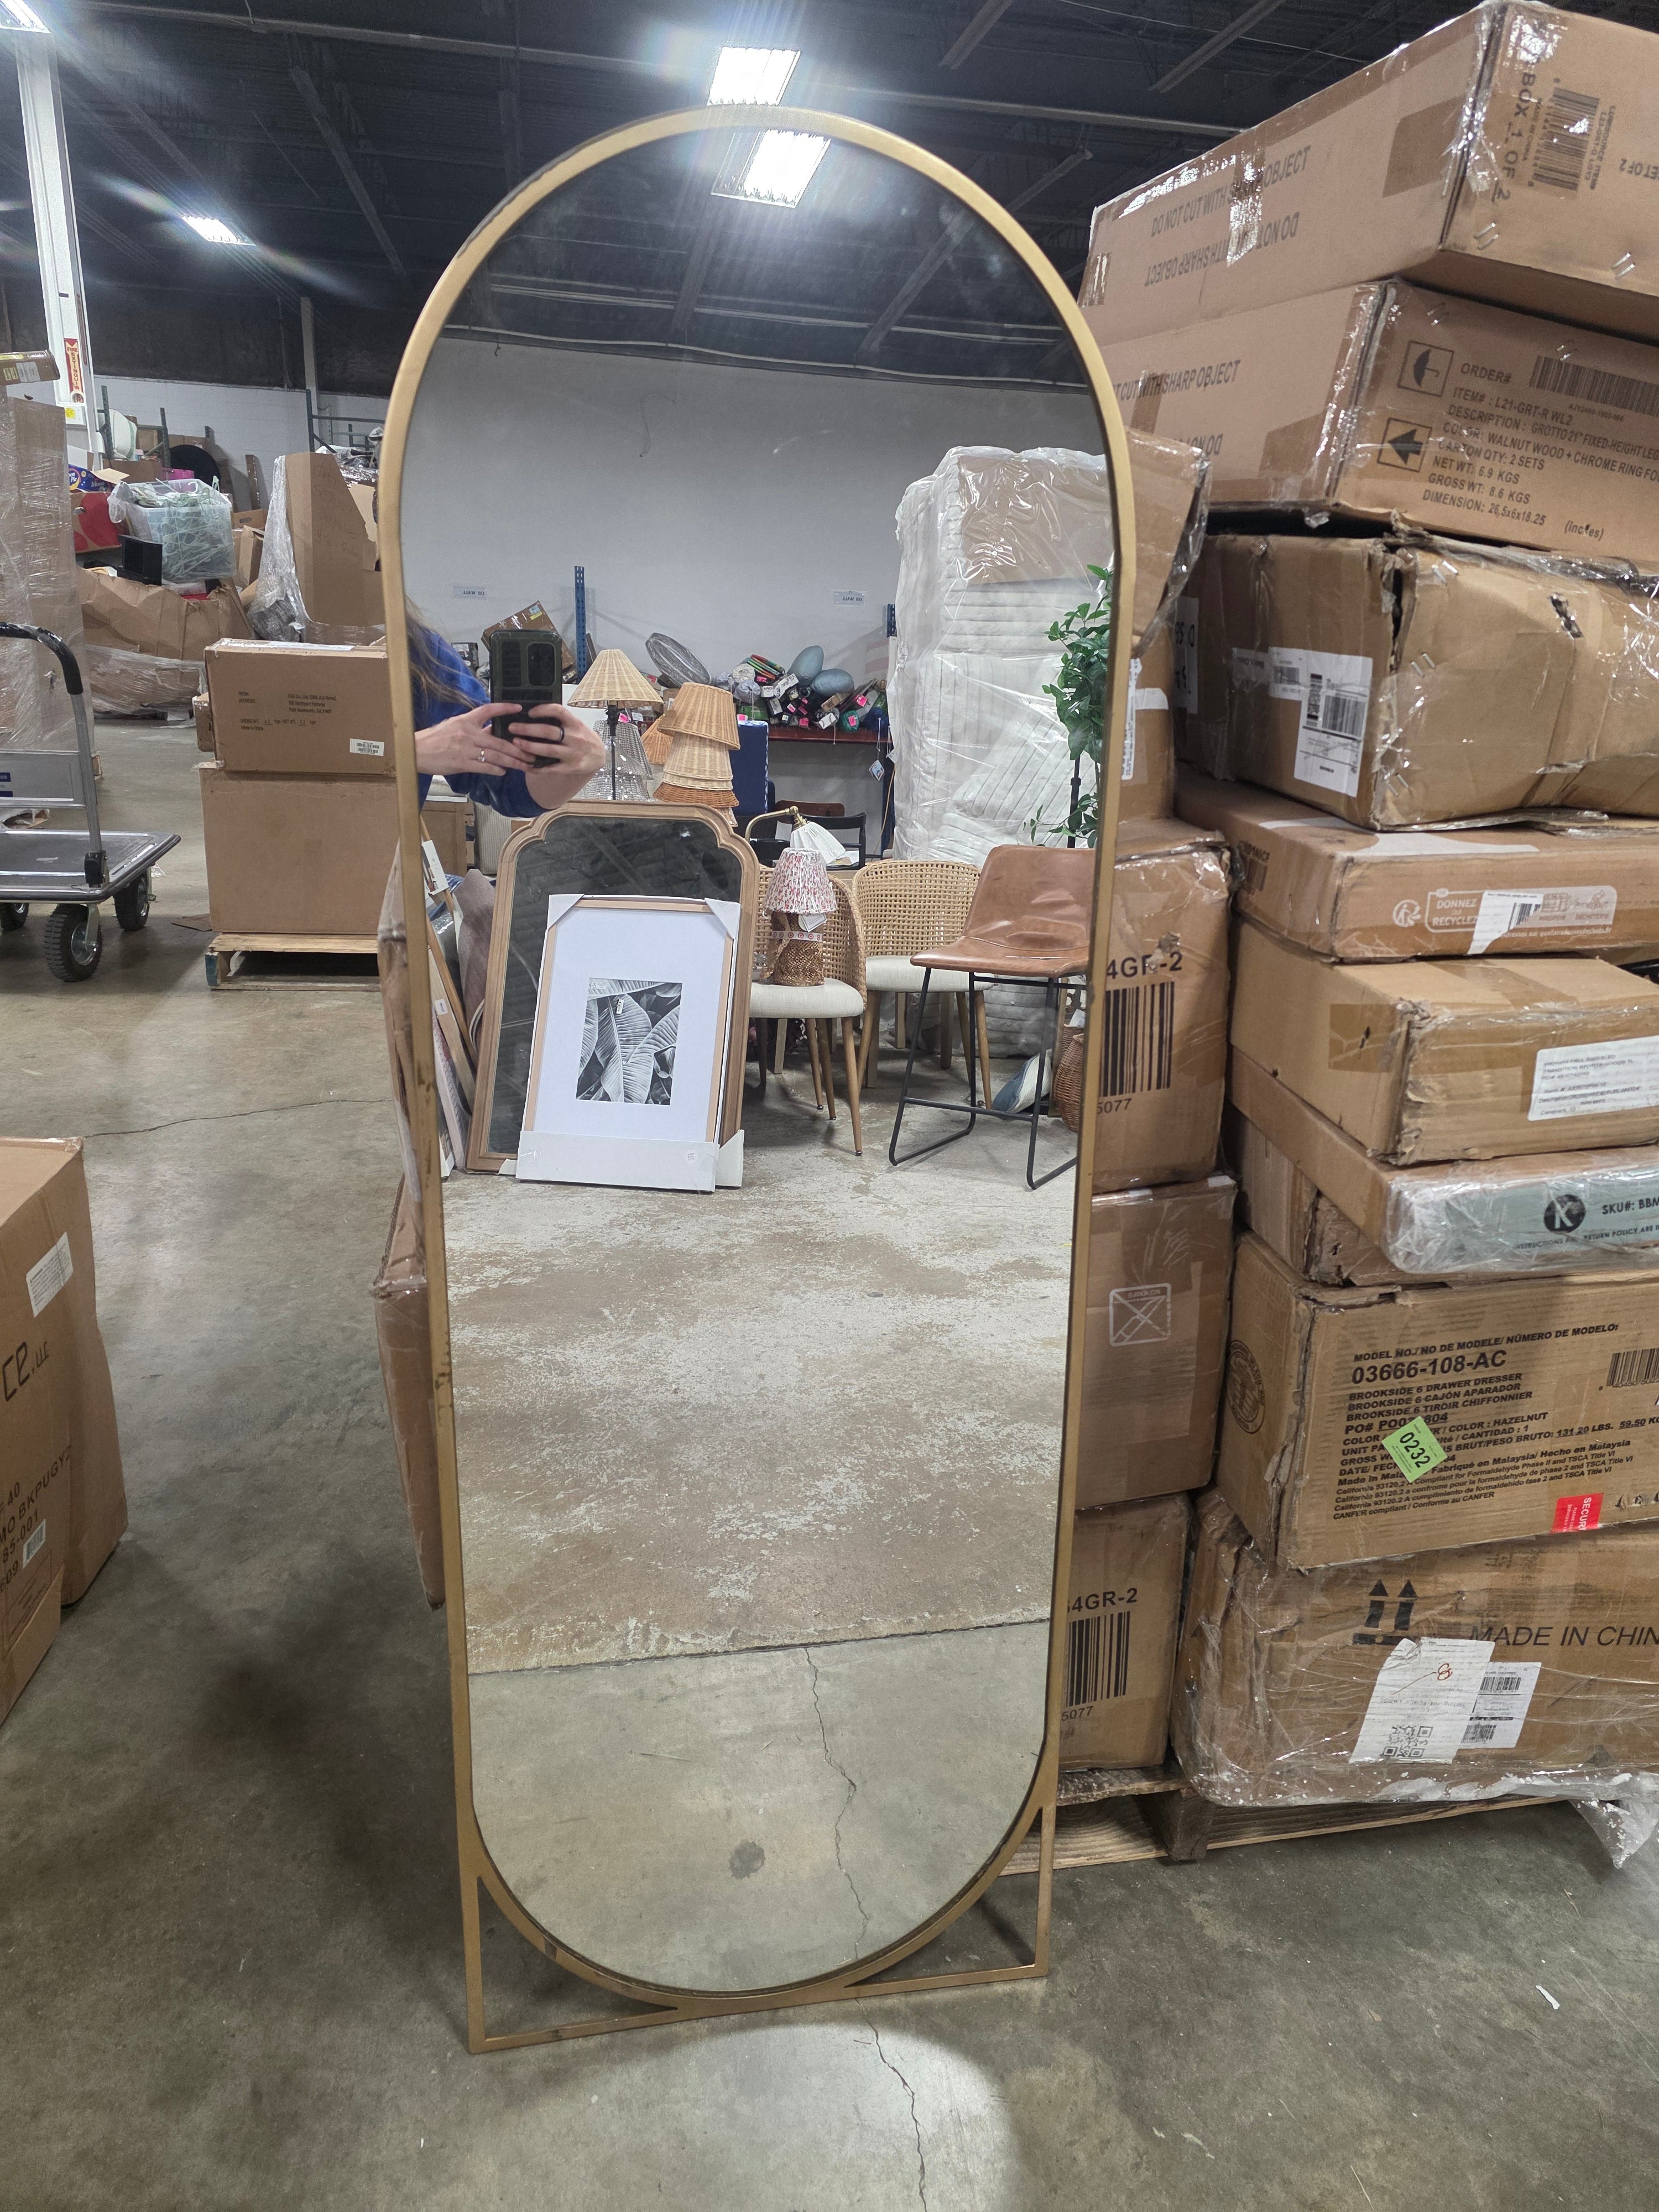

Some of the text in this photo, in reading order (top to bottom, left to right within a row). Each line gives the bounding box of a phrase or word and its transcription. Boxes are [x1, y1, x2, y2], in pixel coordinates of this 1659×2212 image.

[1503, 72, 1536, 179] BOX OF
[1619, 158, 1642, 175] OF 2
[1151, 216, 1163, 237] DO
[1164, 205, 1183, 230] NOT
[1184, 196, 1203, 224] CUT
[1264, 145, 1311, 188] OBJECT
[1282, 212, 1300, 241] DO
[1145, 257, 1178, 286] OBJECT
[1162, 368, 1196, 394] SHARP
[1197, 359, 1240, 388] OBJECT
[1461, 363, 1511, 384] ORDER#
[1453, 388, 1484, 404] ITEM#
[1448, 405, 1642, 457] DESCRIPTION GROTTO FIXED-HEIGHT
[1488, 432, 1531, 455] WALNUT
[1533, 444, 1563, 460] WOOD
[1574, 451, 1618, 472] CHROME
[1618, 462, 1643, 477] RING
[1510, 455, 1516, 465] 2
[1518, 457, 1545, 471] SETS
[1433, 456, 1454, 471] NET
[1498, 470, 1519, 484] KGS
[1423, 489, 1484, 513] DIMENSION:
[1428, 473, 1465, 491] GROSS
[1468, 482, 1484, 495] WT:
[1508, 490, 1531, 505] KGS
[1437, 899, 1477, 909] DONNEZ
[1432, 916, 1478, 926] RECYCLEZ
[1097, 1098, 1132, 1114] 5077
[1602, 1202, 1635, 1214] SKU#:
[1612, 1228, 1637, 1237] POLICY
[1354, 1350, 1392, 1362] MODEL
[1421, 1346, 1437, 1354] NO
[1440, 1344, 1454, 1352] DE
[1506, 1331, 1552, 1344] NÚMERO
[1555, 1329, 1569, 1338] DE
[1572, 1324, 1619, 1336] MODELO:
[1352, 1350, 1506, 1384] 03666-108-AC
[1348, 1397, 1413, 1411] BROOKSIDE
[1425, 1390, 1460, 1402] CAJÓN
[1463, 1383, 1521, 1397] APARADOR
[1349, 1387, 1413, 1401] BROOKSIDE
[1426, 1380, 1471, 1392] DRAWER
[1474, 1373, 1522, 1386] DRESSER
[1346, 1407, 1412, 1422] BROOKSIDE
[1423, 1401, 1459, 1412] TIROIR
[1462, 1391, 1532, 1408] CHIFFONNIER
[1340, 1455, 1377, 1466] GROSS
[1516, 1431, 1553, 1443] BRUTO:
[1592, 1423, 1614, 1432] LBS.
[1619, 1418, 1646, 1429] 59.50
[1342, 1446, 1368, 1456] UNIT
[1462, 1427, 1513, 1441] CANTIDAD
[1343, 1435, 1380, 1446] COLOR
[1449, 1421, 1484, 1433] COLOR
[1494, 1412, 1548, 1427] HAZELNUT
[1345, 1423, 1373, 1434] PO#
[1399, 1432, 1431, 1469] 0232
[1337, 1486, 1374, 1495] California
[1376, 1481, 1405, 1490] 93120.2
[1468, 1465, 1520, 1477] Formaldehyde
[1522, 1460, 1543, 1470] Phase
[1338, 1477, 1366, 1486] Made
[1432, 1463, 1475, 1474] Fabriqué
[1541, 1448, 1571, 1458] Hecho
[1339, 1465, 1370, 1476] DATE/
[1334, 1503, 1371, 1511] California
[1525, 1477, 1541, 1485] fase
[1335, 1495, 1373, 1503] California
[1449, 1482, 1467, 1490] pour
[1478, 1474, 1528, 1485] formaldehyde
[1540, 1467, 1562, 1476] phase
[1333, 1510, 1367, 1520] CANFER
[1369, 1504, 1406, 1514] compliant
[1413, 1499, 1449, 1509] Conforme
[1462, 1492, 1495, 1501] CANFER
[1470, 1626, 1553, 1646] MADE
[1561, 1626, 1590, 1646] IN
[1061, 1705, 1093, 1721] 5077
